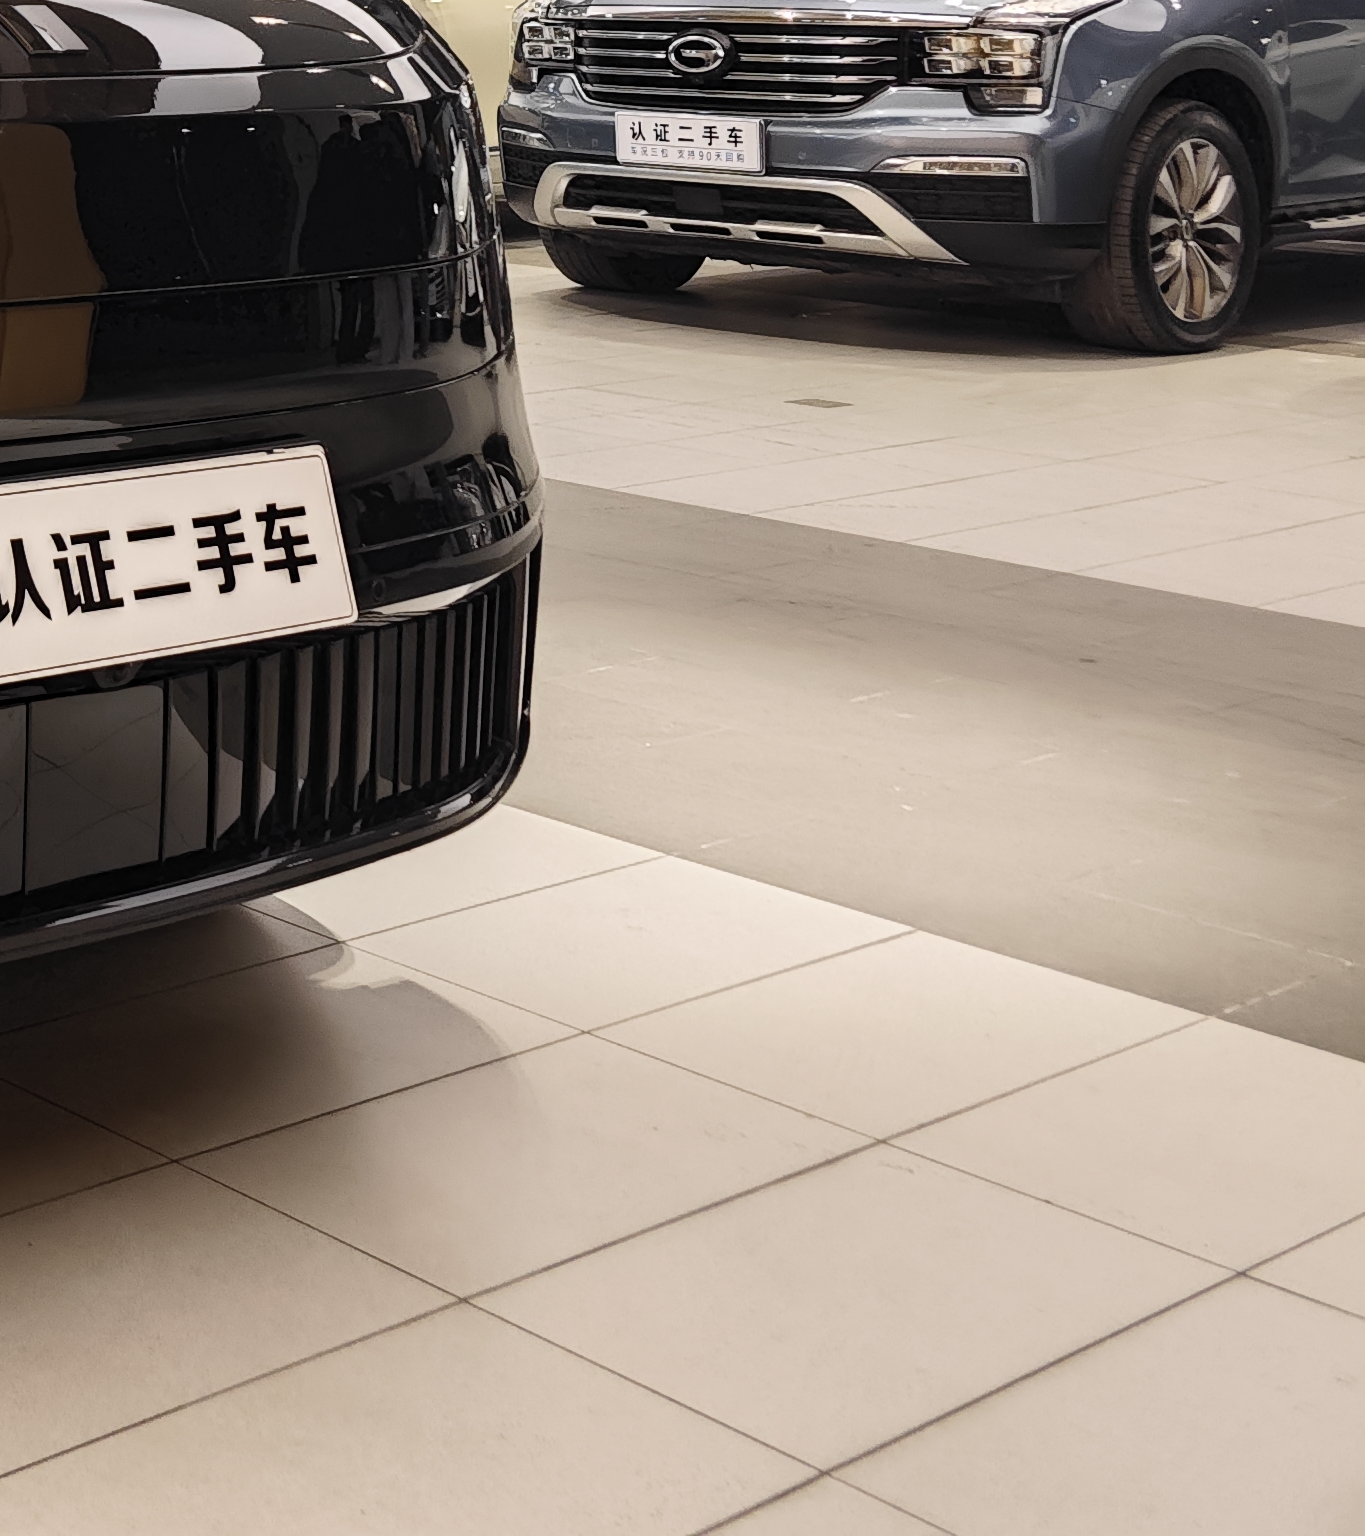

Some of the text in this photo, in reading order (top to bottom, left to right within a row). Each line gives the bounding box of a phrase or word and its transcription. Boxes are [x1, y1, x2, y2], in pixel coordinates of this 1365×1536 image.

[630, 121, 744, 147] 认证二手车
[630, 146, 745, 163] 车况三包 支持90天回购
